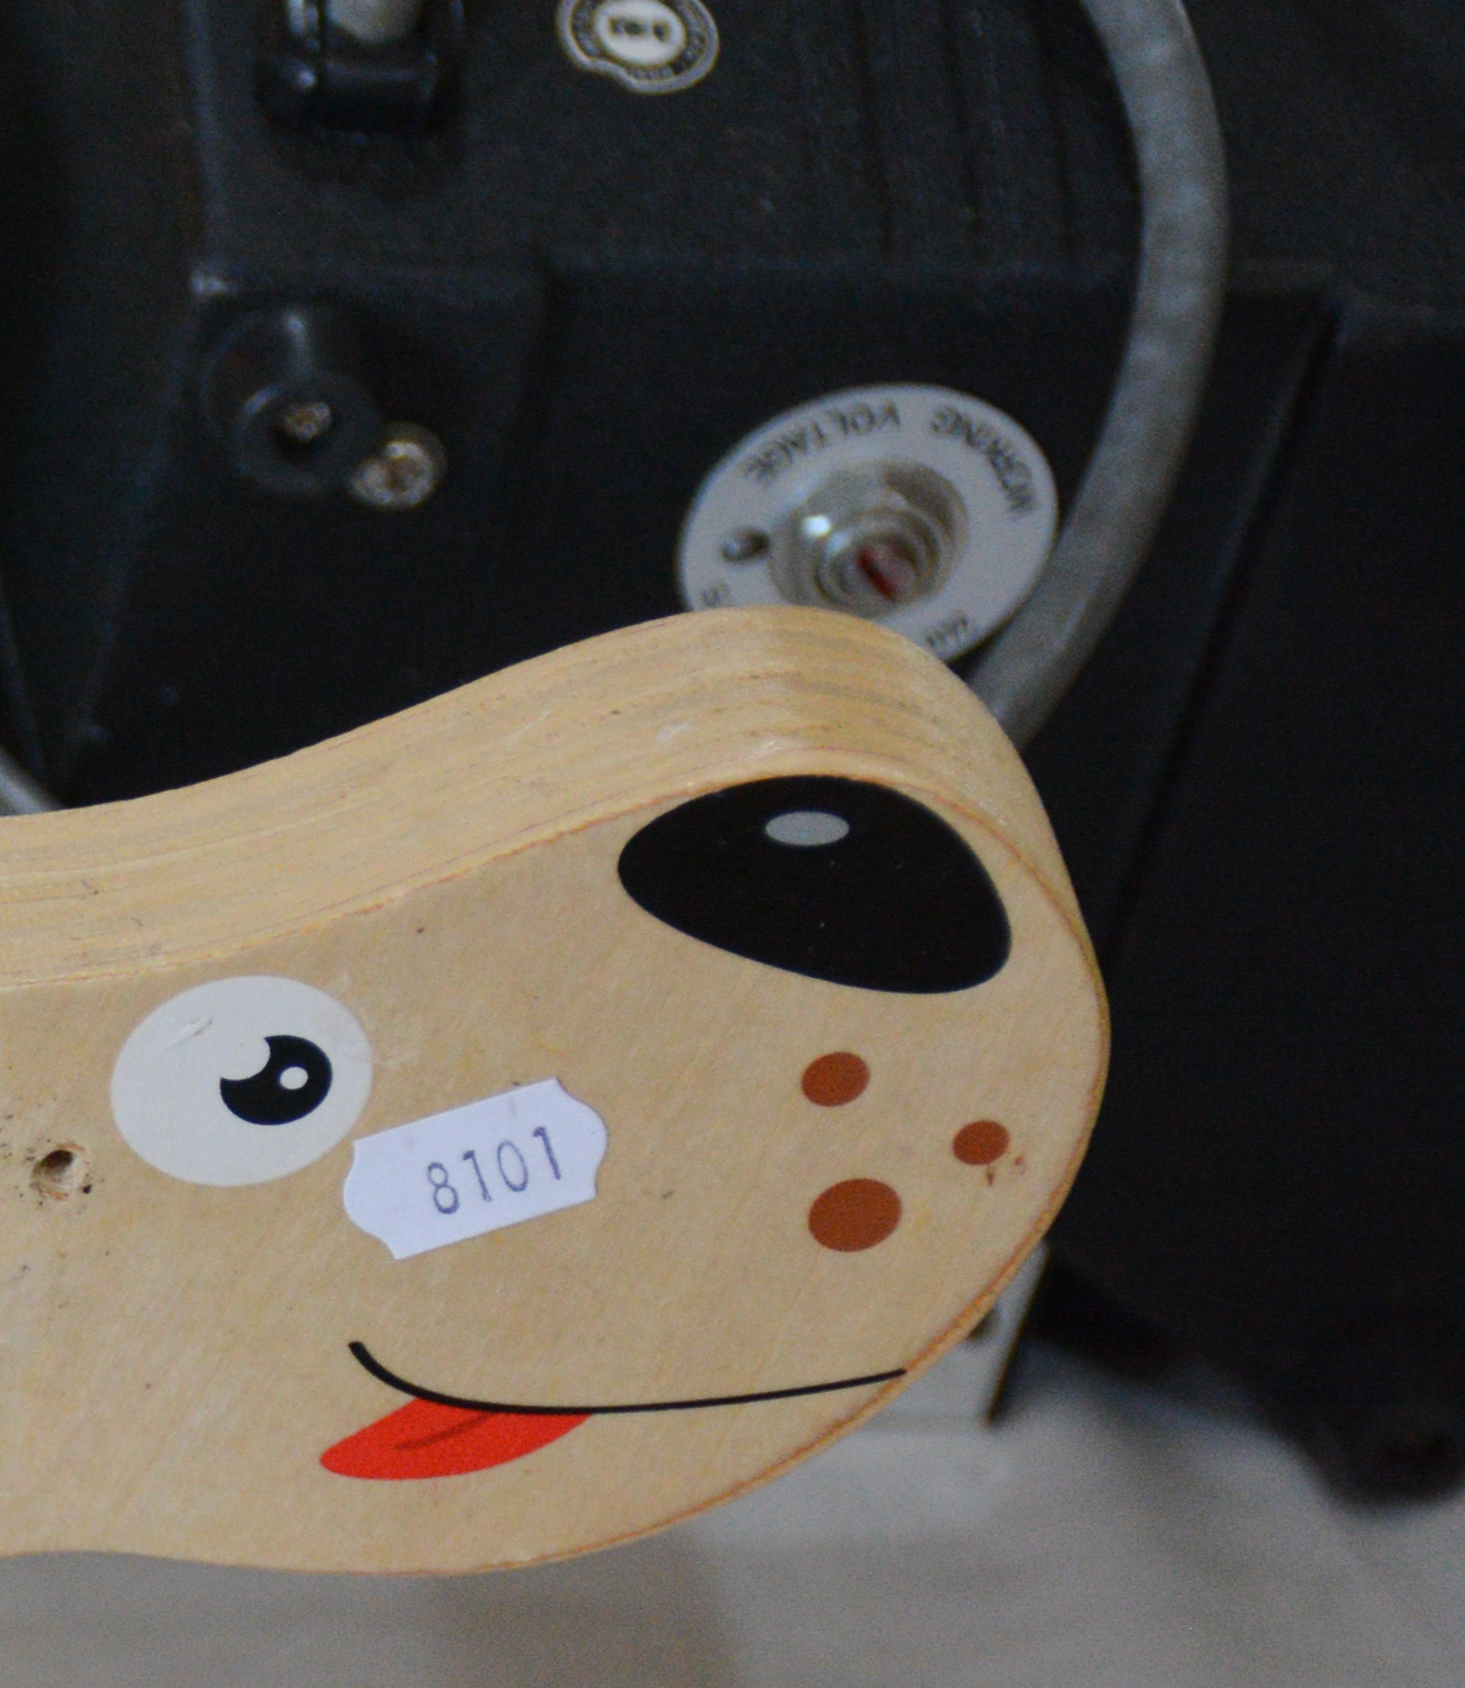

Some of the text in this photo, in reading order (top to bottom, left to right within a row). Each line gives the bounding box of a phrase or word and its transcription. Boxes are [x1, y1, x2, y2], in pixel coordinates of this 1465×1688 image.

[744, 401, 1037, 520] WORKING VOLTAGE
[426, 1126, 562, 1215] 8101
